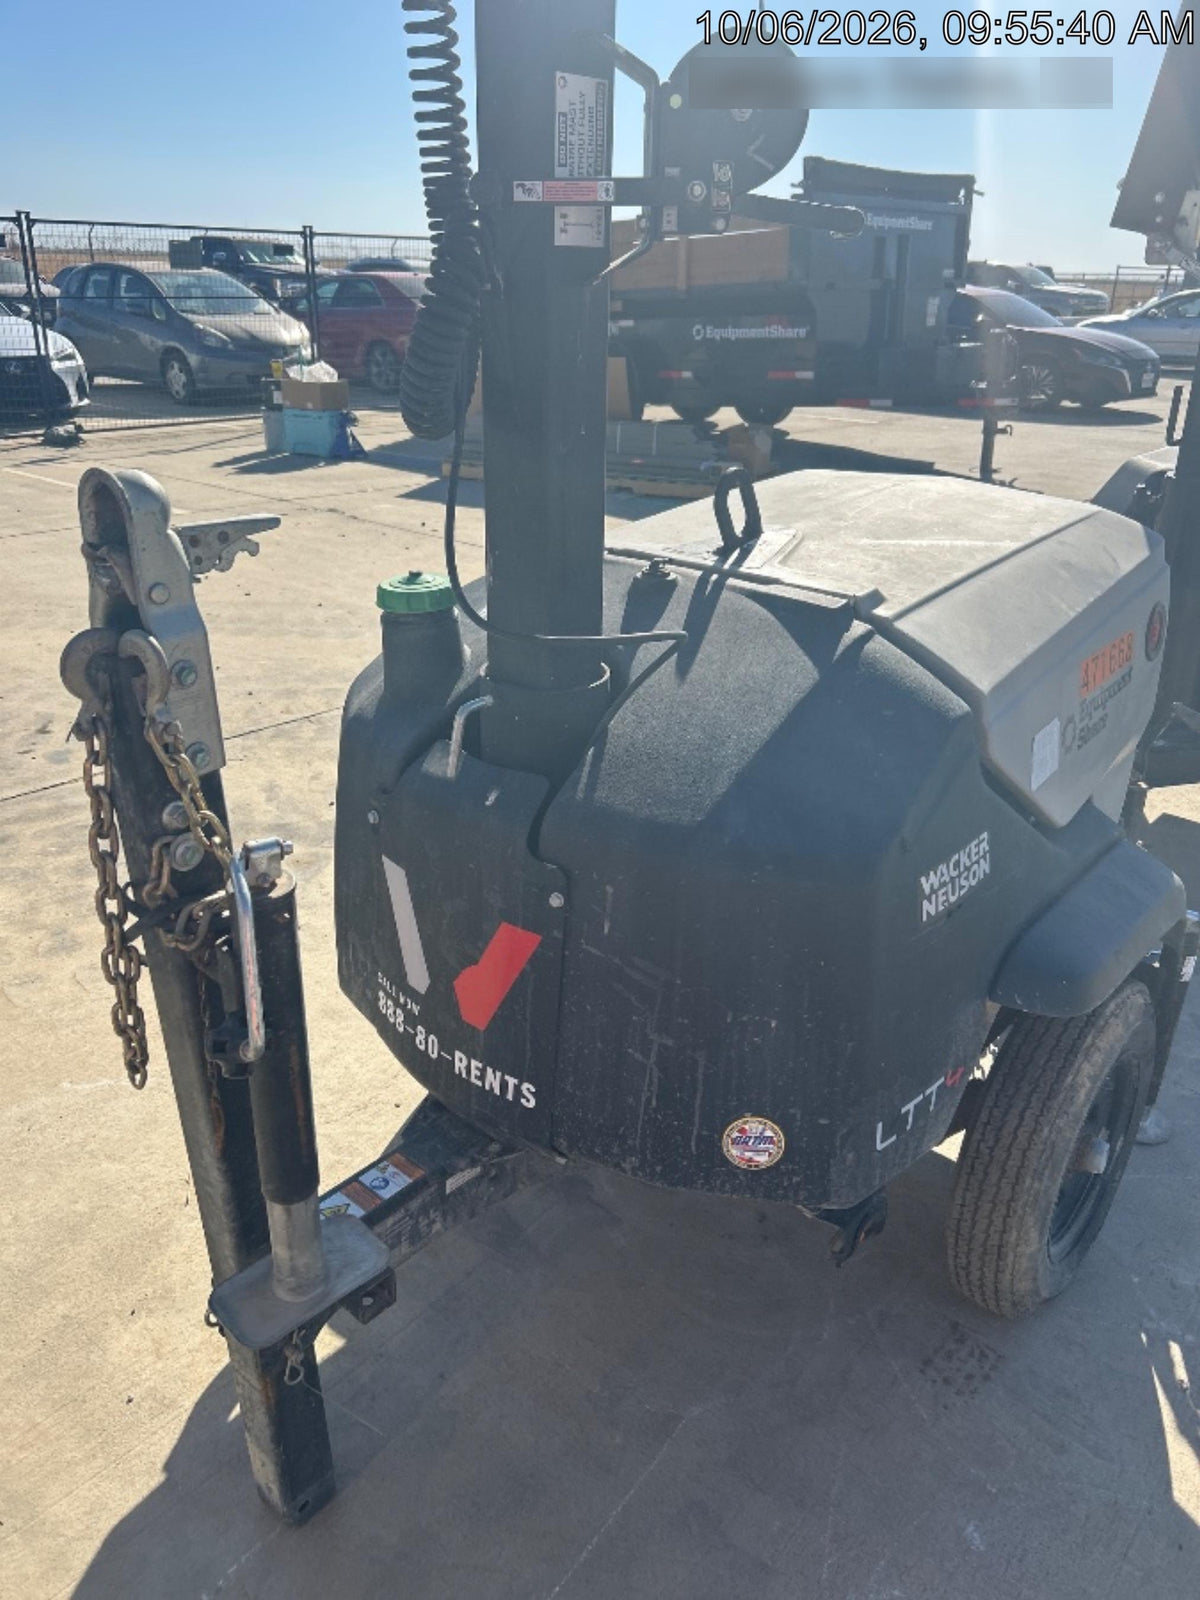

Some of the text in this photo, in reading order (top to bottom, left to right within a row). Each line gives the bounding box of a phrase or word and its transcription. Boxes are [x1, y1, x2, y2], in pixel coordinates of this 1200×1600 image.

[705, 324, 807, 341] EquipmentShare
[1080, 632, 1134, 692] 471668
[920, 831, 990, 896] WACKER
[921, 853, 991, 922] NEUSON
[377, 990, 537, 1109] 888-80-RENTS
